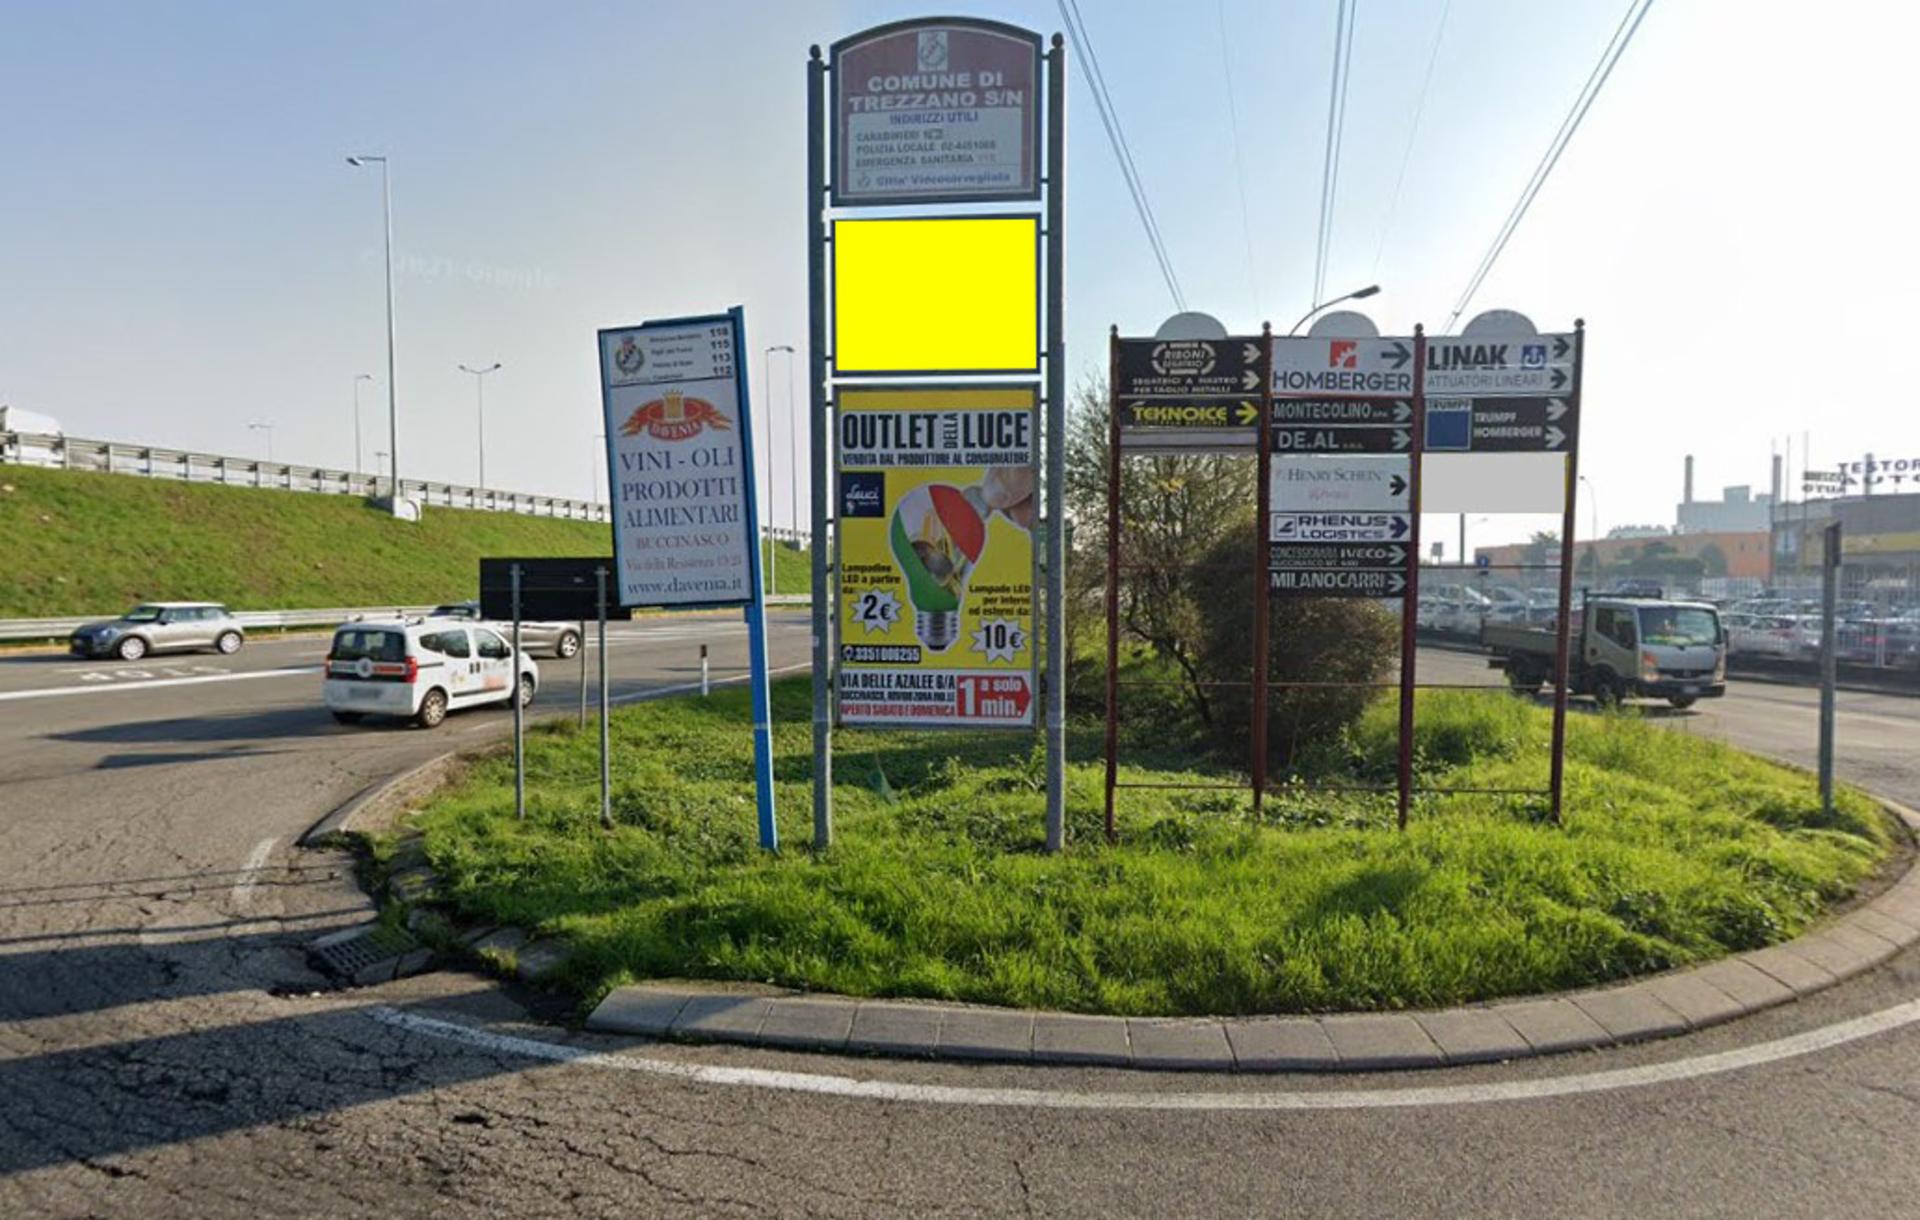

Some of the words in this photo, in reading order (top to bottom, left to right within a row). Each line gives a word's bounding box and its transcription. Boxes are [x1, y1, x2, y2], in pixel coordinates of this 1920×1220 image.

[867, 73, 972, 92] COMUNE
[979, 71, 1004, 87] DI
[848, 92, 977, 111] TREZZANO
[984, 89, 1023, 106] S/N
[890, 113, 944, 125] INDIRIZZI
[947, 111, 978, 122] UTILI
[856, 131, 919, 142] CARABINIERI
[856, 144, 895, 155] POLIZIA
[898, 142, 934, 153] LOCALE
[856, 157, 916, 168] EMERGENZA
[920, 154, 974, 165] SANITARIA
[709, 327, 729, 337] 118
[711, 339, 730, 349] 115
[712, 352, 731, 362] 113
[1163, 350, 1205, 360] RIBONI
[1427, 344, 1509, 370] LINAK
[713, 366, 732, 375] 112
[1272, 371, 1411, 391] HOMBERGER
[1428, 374, 1492, 387] ATTUATORI
[1495, 374, 1543, 387] LINEARI
[1154, 385, 1189, 393] TAGLIO
[1191, 385, 1231, 393] METALLI
[1273, 402, 1371, 418] MONTECOLINO
[1474, 412, 1517, 422] TRUMPF
[842, 413, 937, 449] OUTLET
[944, 413, 958, 449] DELLA
[963, 412, 1029, 448] LUCE
[1473, 426, 1543, 438] HOMBERGER
[1278, 431, 1339, 449] DE.AL
[620, 451, 671, 473] VINI
[691, 447, 735, 468] OLI
[842, 453, 877, 465] VENDITA
[879, 453, 895, 465] DAL
[897, 452, 950, 464] PRODUTTORE
[952, 452, 963, 464] AL
[965, 451, 1030, 464] CONSUMATORE
[622, 476, 737, 501] PRODOTTI
[624, 504, 739, 529] ALIMENTARI
[1298, 515, 1388, 527] RHENUS
[1301, 529, 1385, 539] LOGISTICS
[636, 533, 729, 549] BUCCINASCO
[1340, 548, 1387, 558] IVECO
[842, 563, 892, 574] Lampadine
[627, 574, 742, 594] www.davenia.it
[842, 575, 859, 584] LED
[861, 576, 869, 584] a
[870, 574, 900, 585] partire
[1271, 572, 1385, 588] MILANOCARRI
[968, 584, 1010, 595] Lampade
[1013, 584, 1031, 593] LED
[983, 596, 998, 605] per
[1000, 595, 1030, 605] interni
[982, 606, 1014, 616] esterni
[840, 674, 859, 688] VIA
[861, 674, 892, 688] DELLE
[894, 674, 933, 689] AZALEE
[981, 680, 989, 691] a
[992, 678, 1022, 691] solo
[960, 679, 975, 716] 1
[981, 697, 1022, 716] min.
